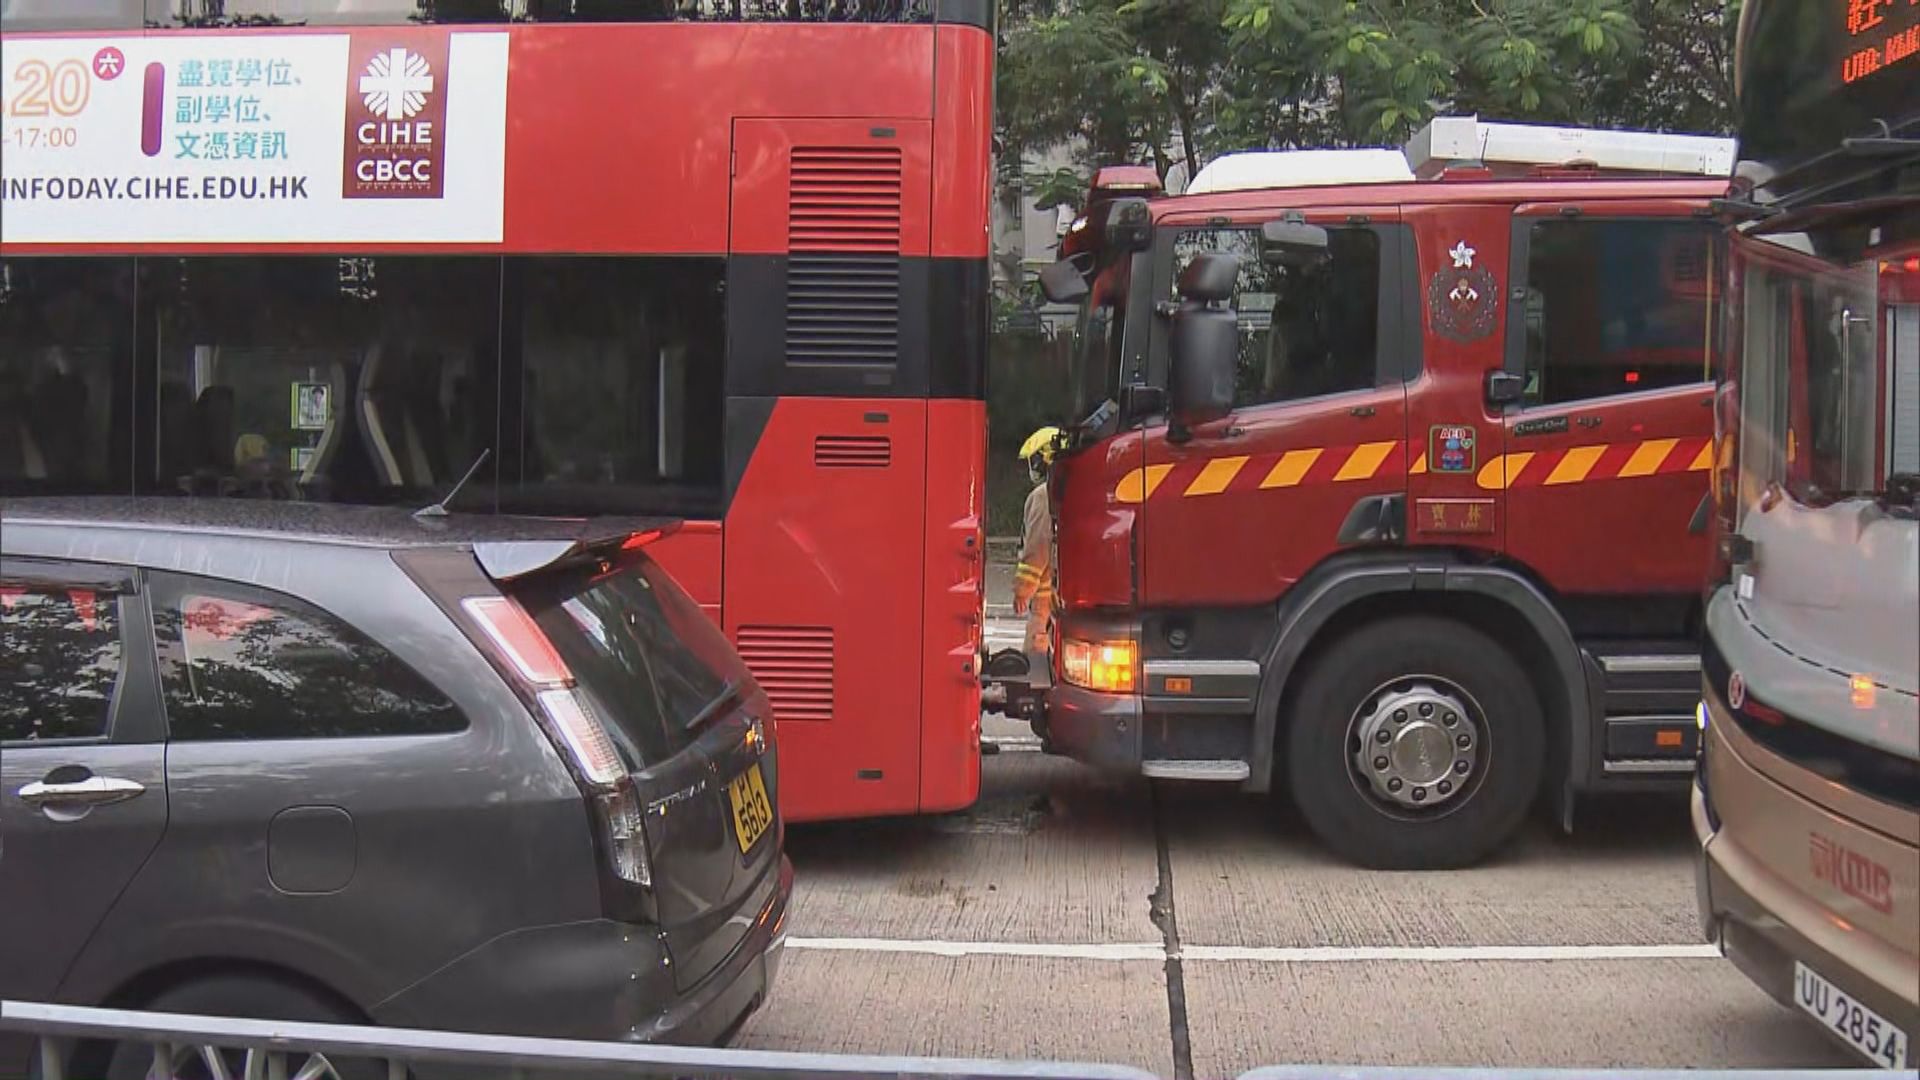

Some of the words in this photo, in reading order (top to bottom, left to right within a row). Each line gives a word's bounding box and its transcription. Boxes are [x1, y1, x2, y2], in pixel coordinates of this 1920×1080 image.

[98, 52, 120, 76] 六
[175, 94, 272, 124] 副學位、
[174, 131, 289, 160] 文憑資訊
[357, 122, 433, 144] CIHE
[356, 159, 432, 182] CBCC
[2, 176, 309, 200] INFODAY.CIHE.EDU.HK
[738, 789, 768, 843] 5613
[1800, 969, 1830, 1017] UU
[1835, 996, 1898, 1068] 2854
